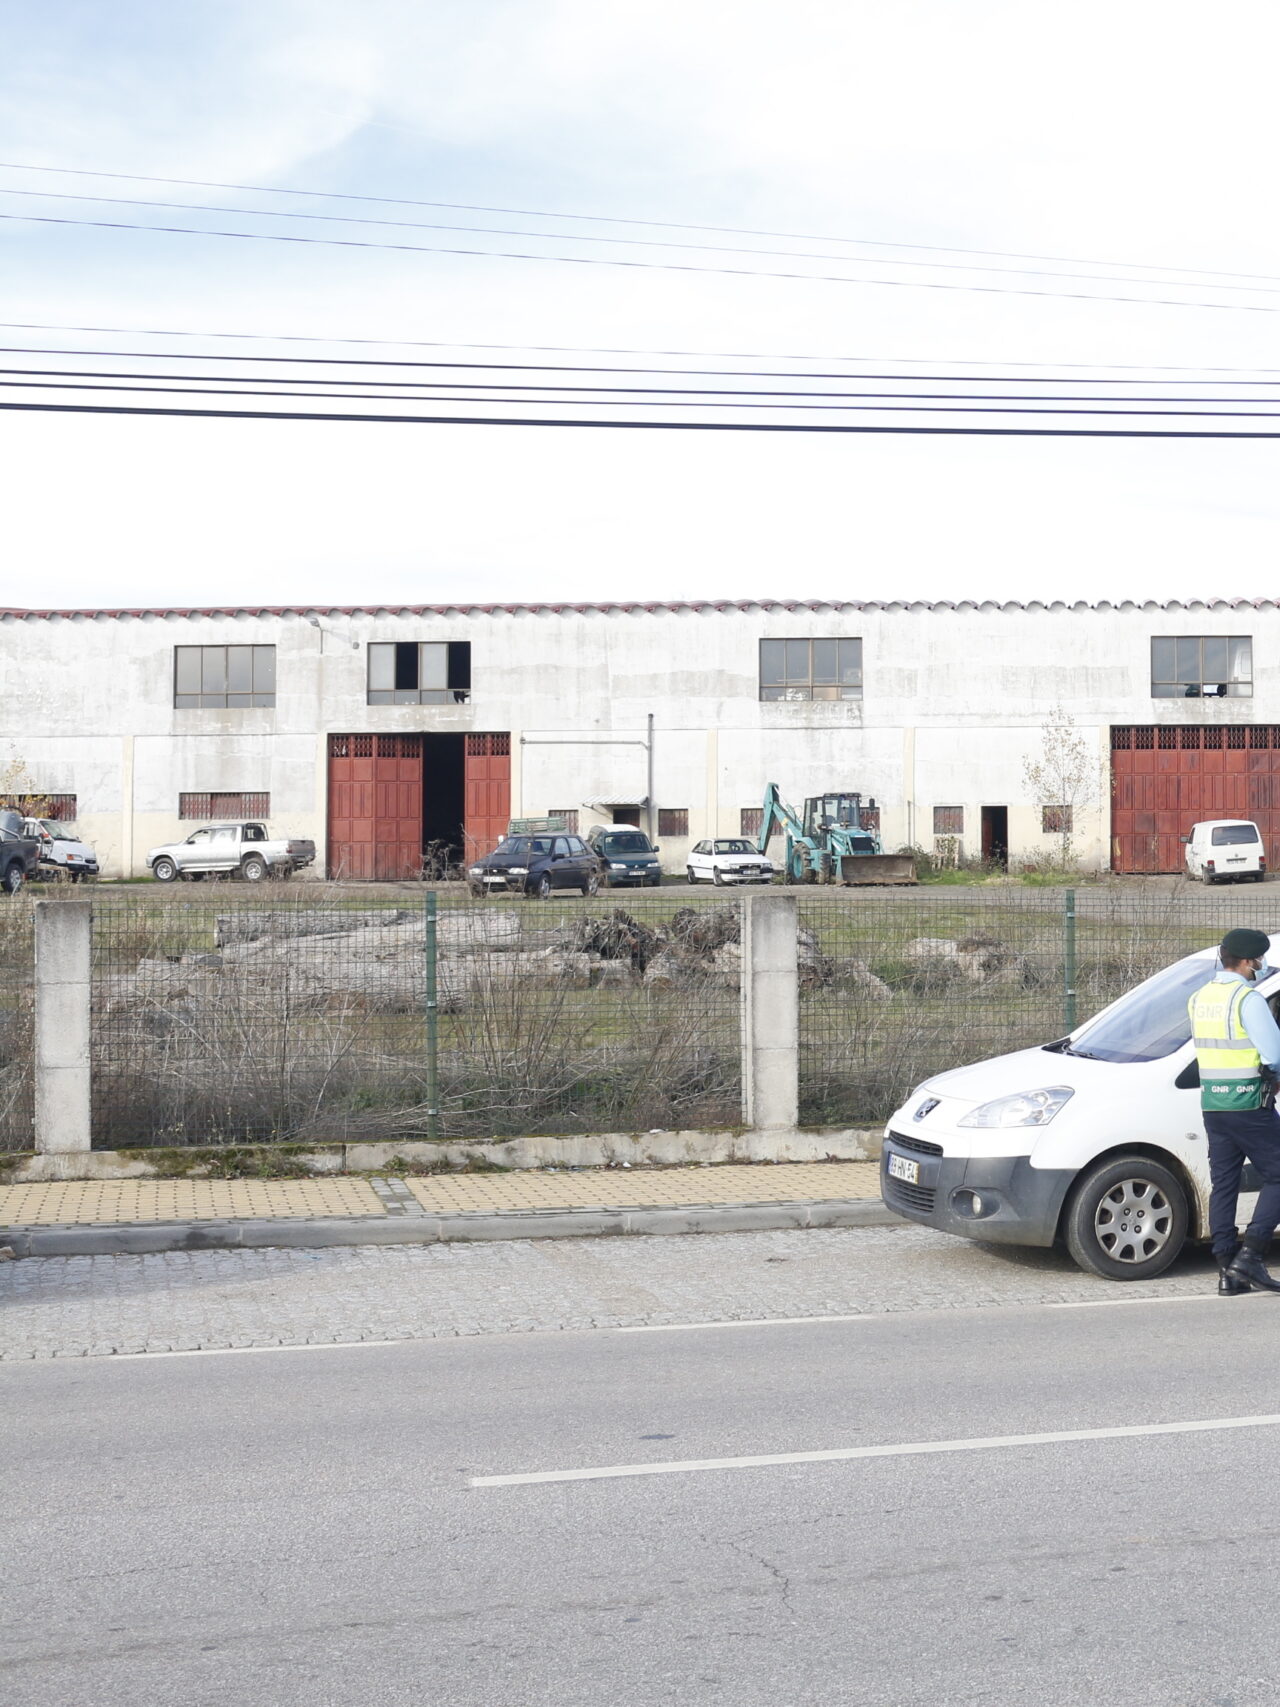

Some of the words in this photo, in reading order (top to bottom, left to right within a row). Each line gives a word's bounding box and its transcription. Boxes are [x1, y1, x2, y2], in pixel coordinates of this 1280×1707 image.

[1197, 1006, 1222, 1018] GNR
[1211, 1085, 1229, 1093] GNR
[1236, 1084, 1255, 1093] GNR
